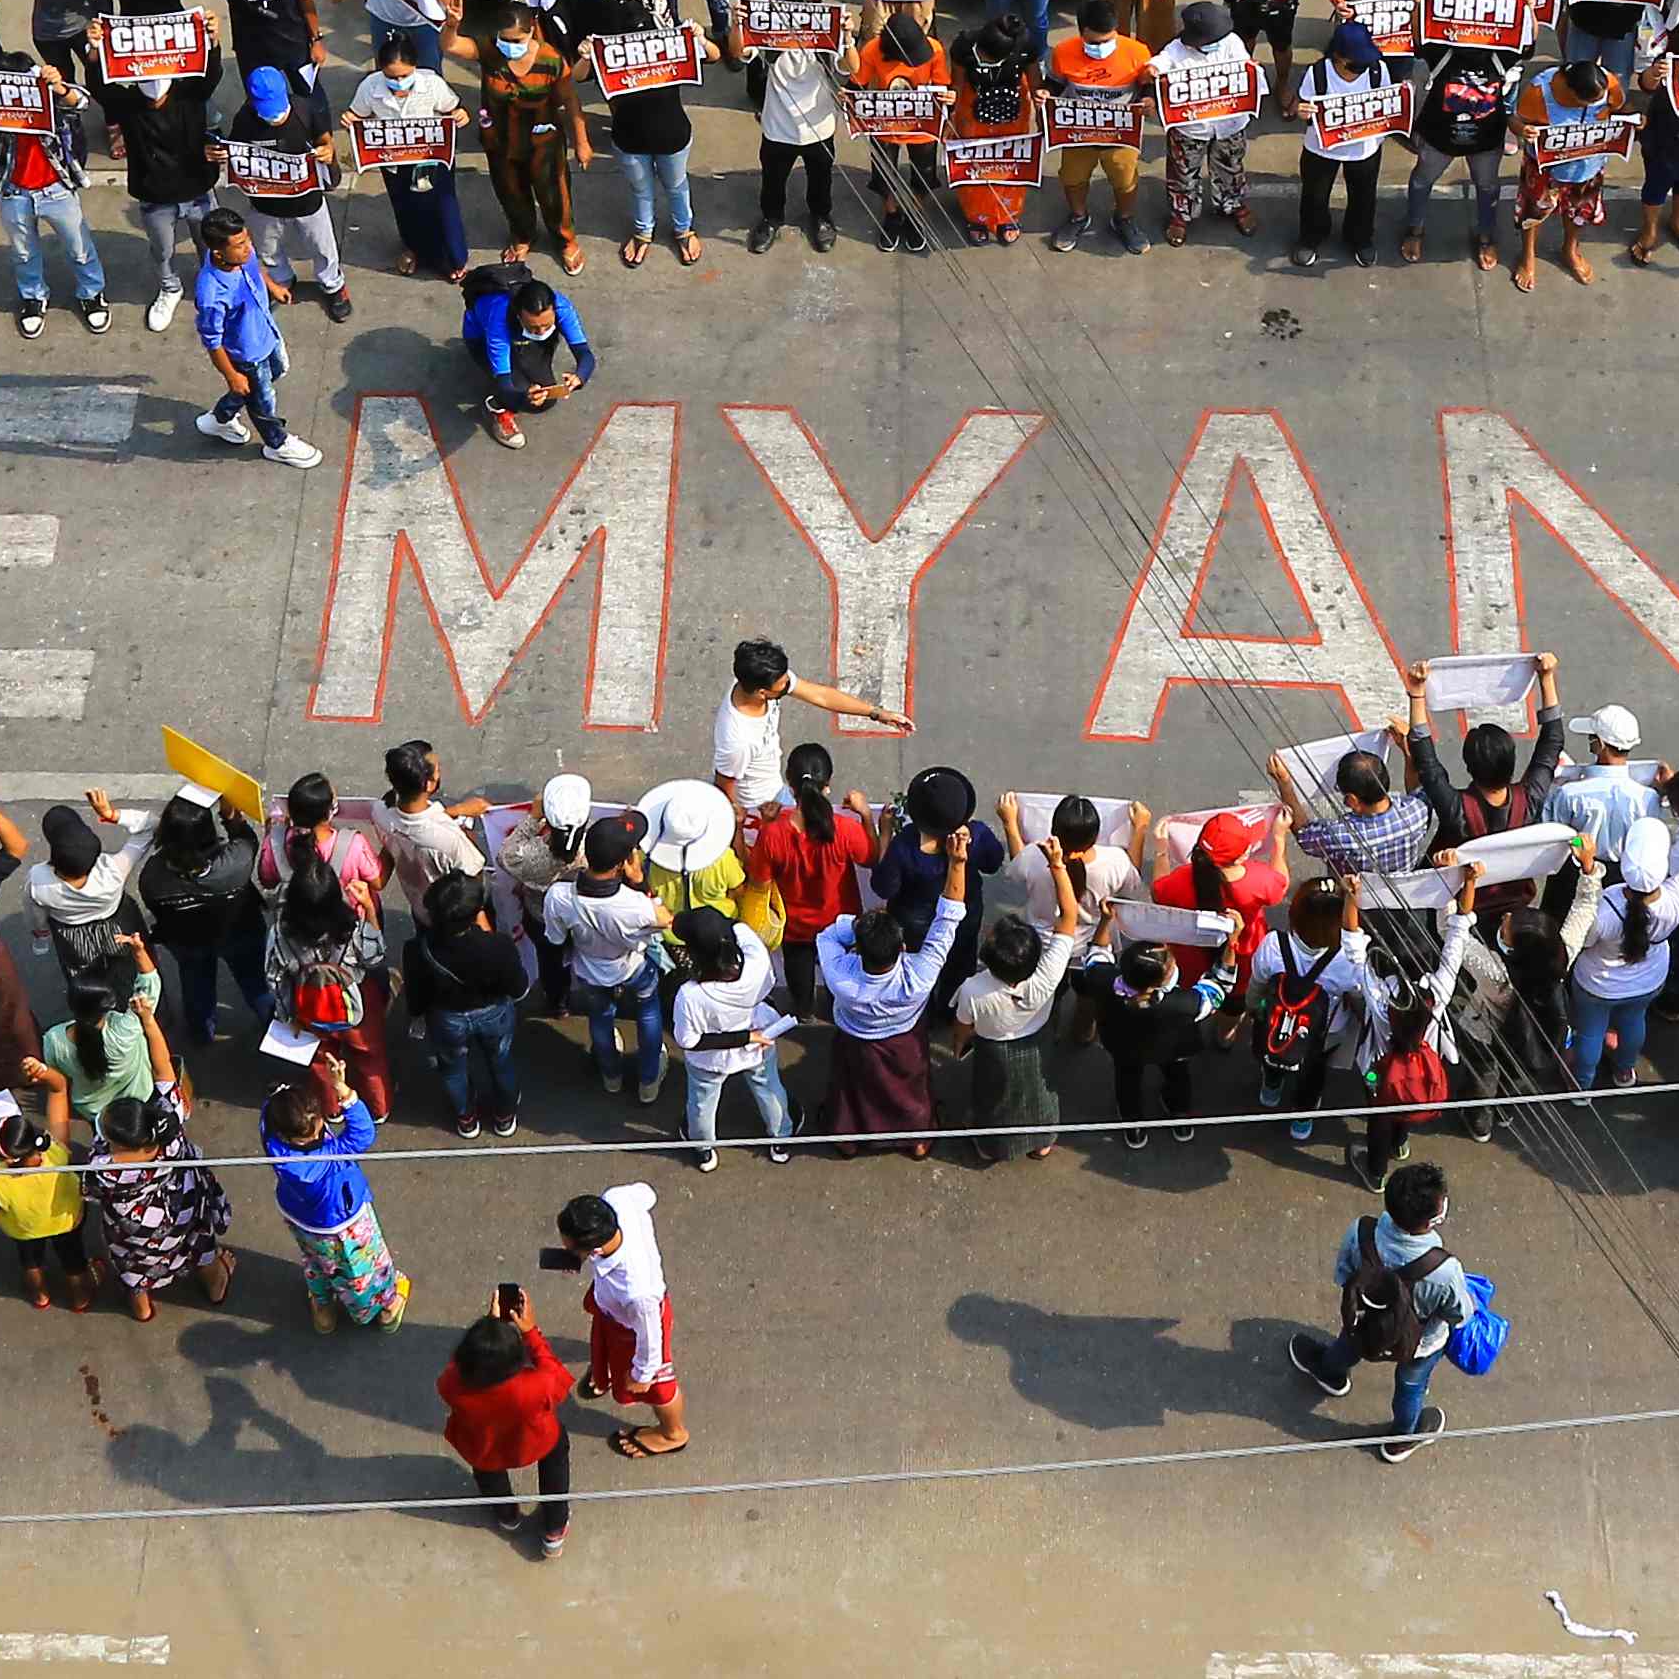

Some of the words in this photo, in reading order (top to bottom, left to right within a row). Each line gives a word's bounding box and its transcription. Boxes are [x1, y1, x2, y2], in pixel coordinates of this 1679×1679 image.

[110, 16, 129, 26] WE
[134, 14, 193, 25] SUPPORT
[750, 11, 831, 31] CRPH
[110, 23, 197, 53] CRPH
[604, 37, 685, 68] CRPH
[1169, 70, 1186, 82] WE
[1190, 62, 1246, 78] SUPPORT
[1169, 74, 1247, 104] CRPH
[856, 100, 933, 118] CRPH
[1055, 109, 1133, 127] CRPH
[1324, 98, 1402, 127] CRPH
[363, 127, 444, 146] CRPH
[1545, 125, 1623, 149] CRPH
[230, 154, 308, 180] CRPH
